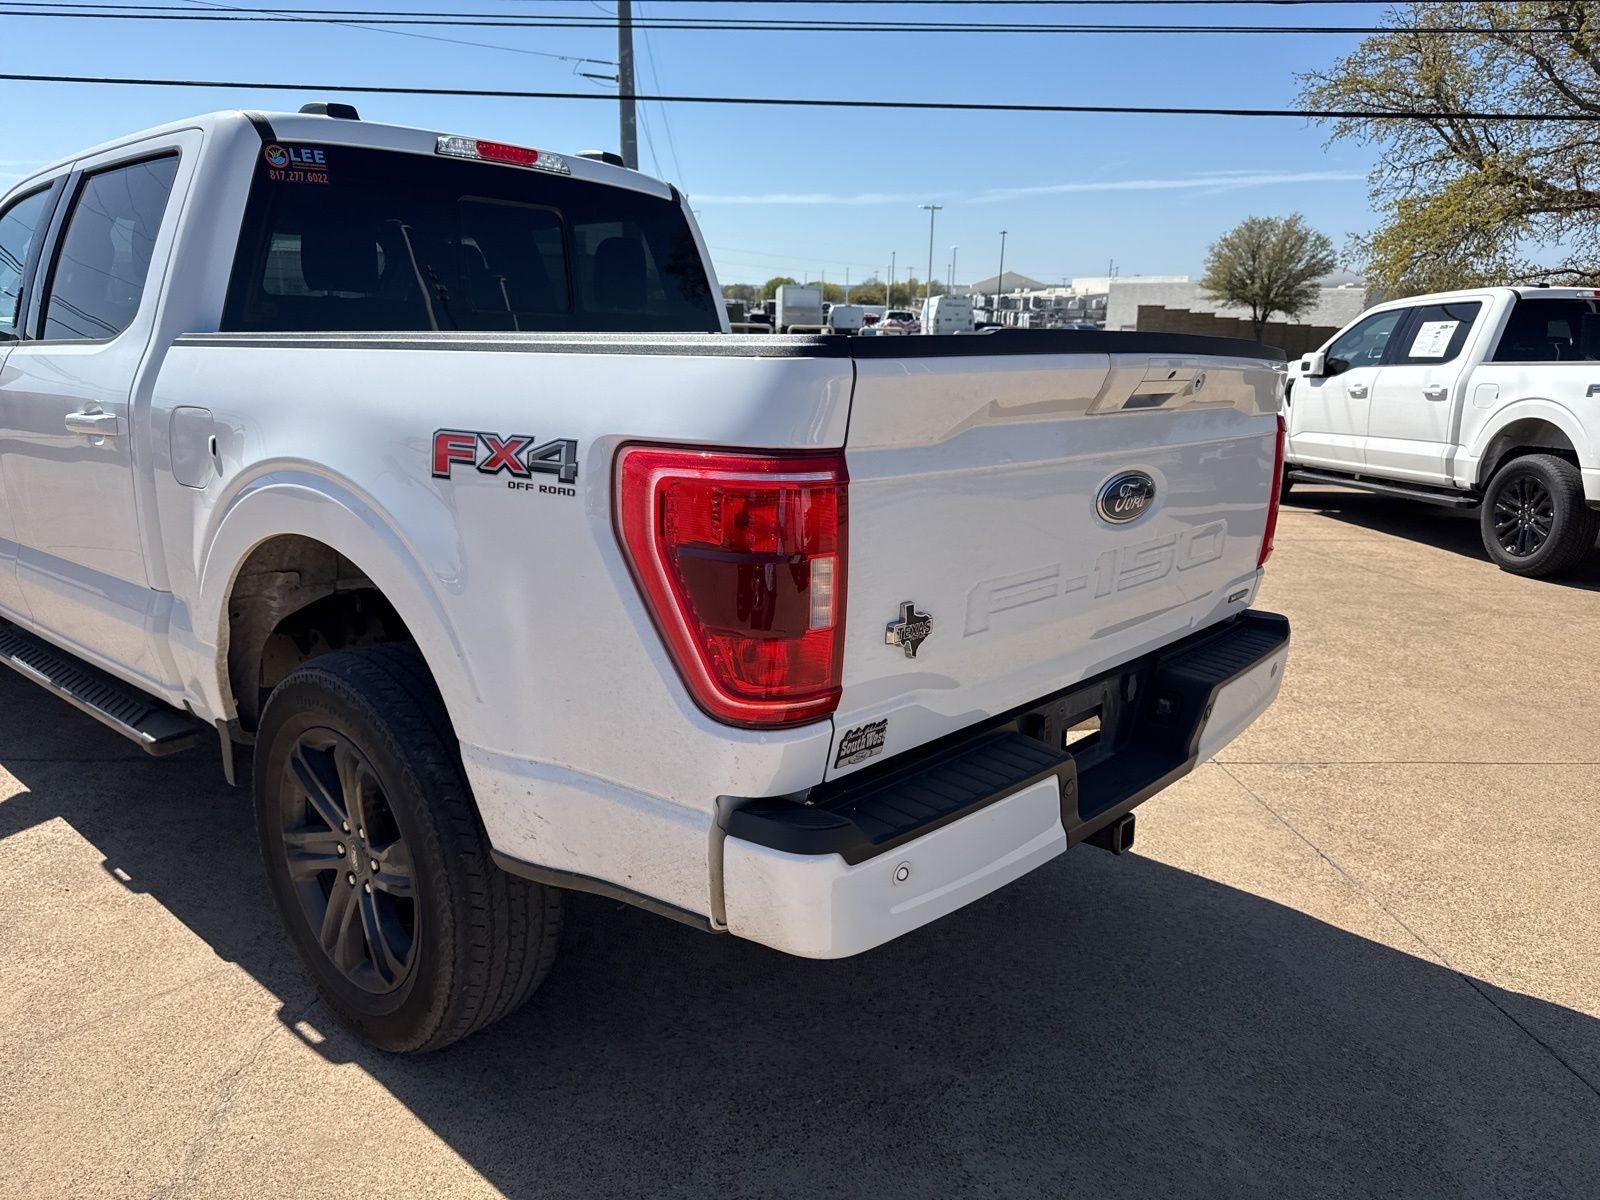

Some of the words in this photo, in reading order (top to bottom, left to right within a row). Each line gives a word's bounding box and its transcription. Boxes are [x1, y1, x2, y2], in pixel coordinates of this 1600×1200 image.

[289, 147, 326, 163] LEE
[269, 169, 329, 183] 817.277.6022
[432, 428, 578, 485] FX4
[508, 481, 534, 490] OFF
[539, 485, 577, 497] ROAD
[1115, 483, 1147, 512] Ford
[963, 519, 1228, 637] F-150
[896, 620, 932, 640] TEXAS
